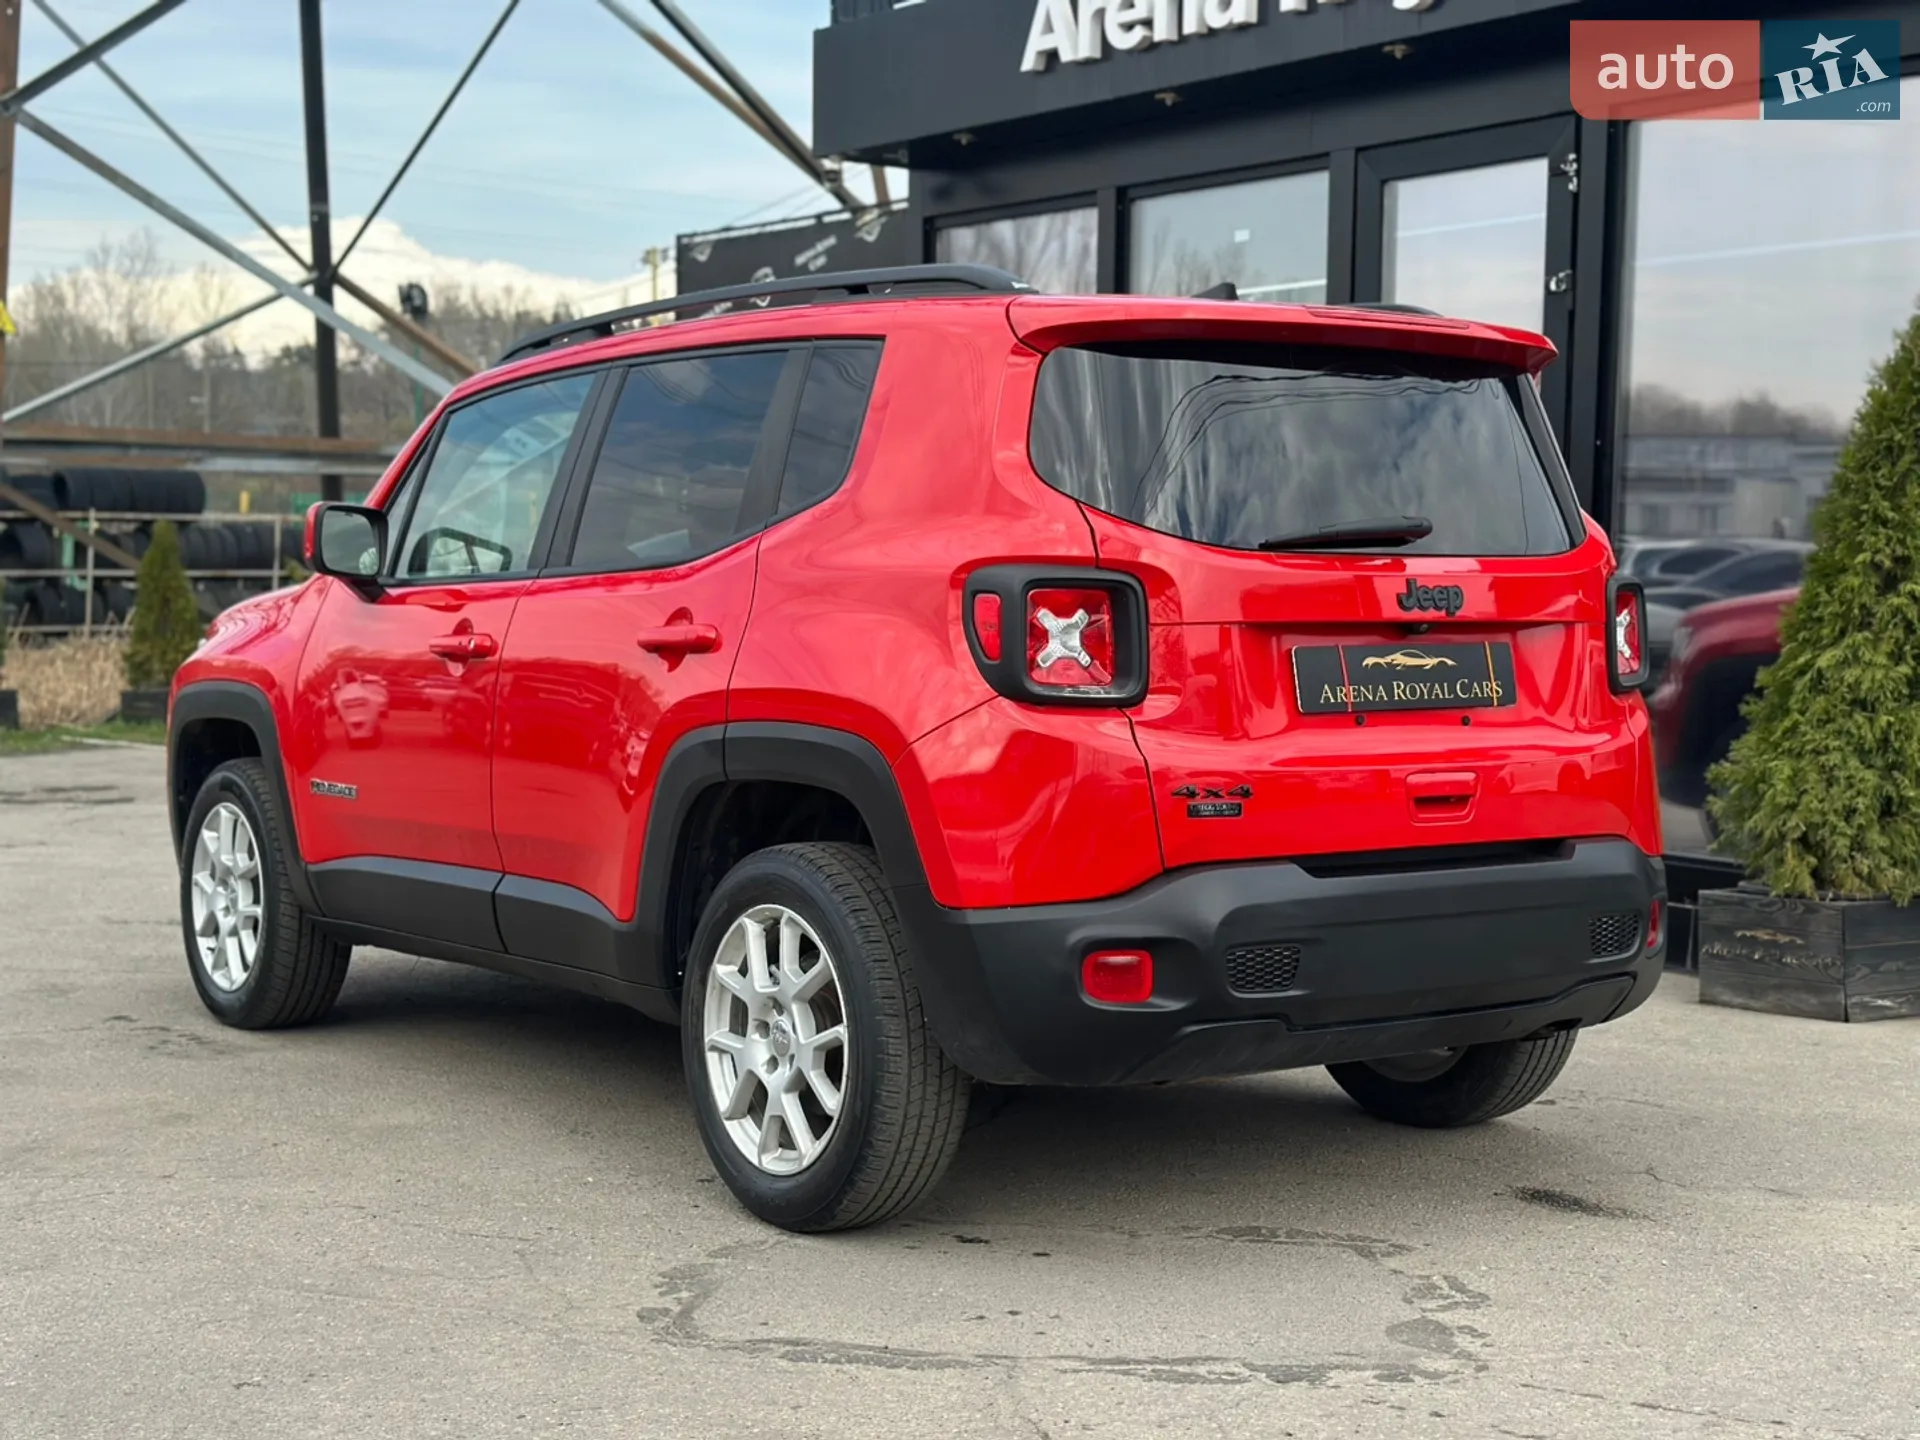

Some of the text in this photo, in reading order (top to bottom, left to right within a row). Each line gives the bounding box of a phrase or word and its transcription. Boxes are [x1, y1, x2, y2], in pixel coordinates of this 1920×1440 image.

[1397, 578, 1464, 617] Jeep
[1319, 678, 1503, 704] ARENA ROYAL CARS
